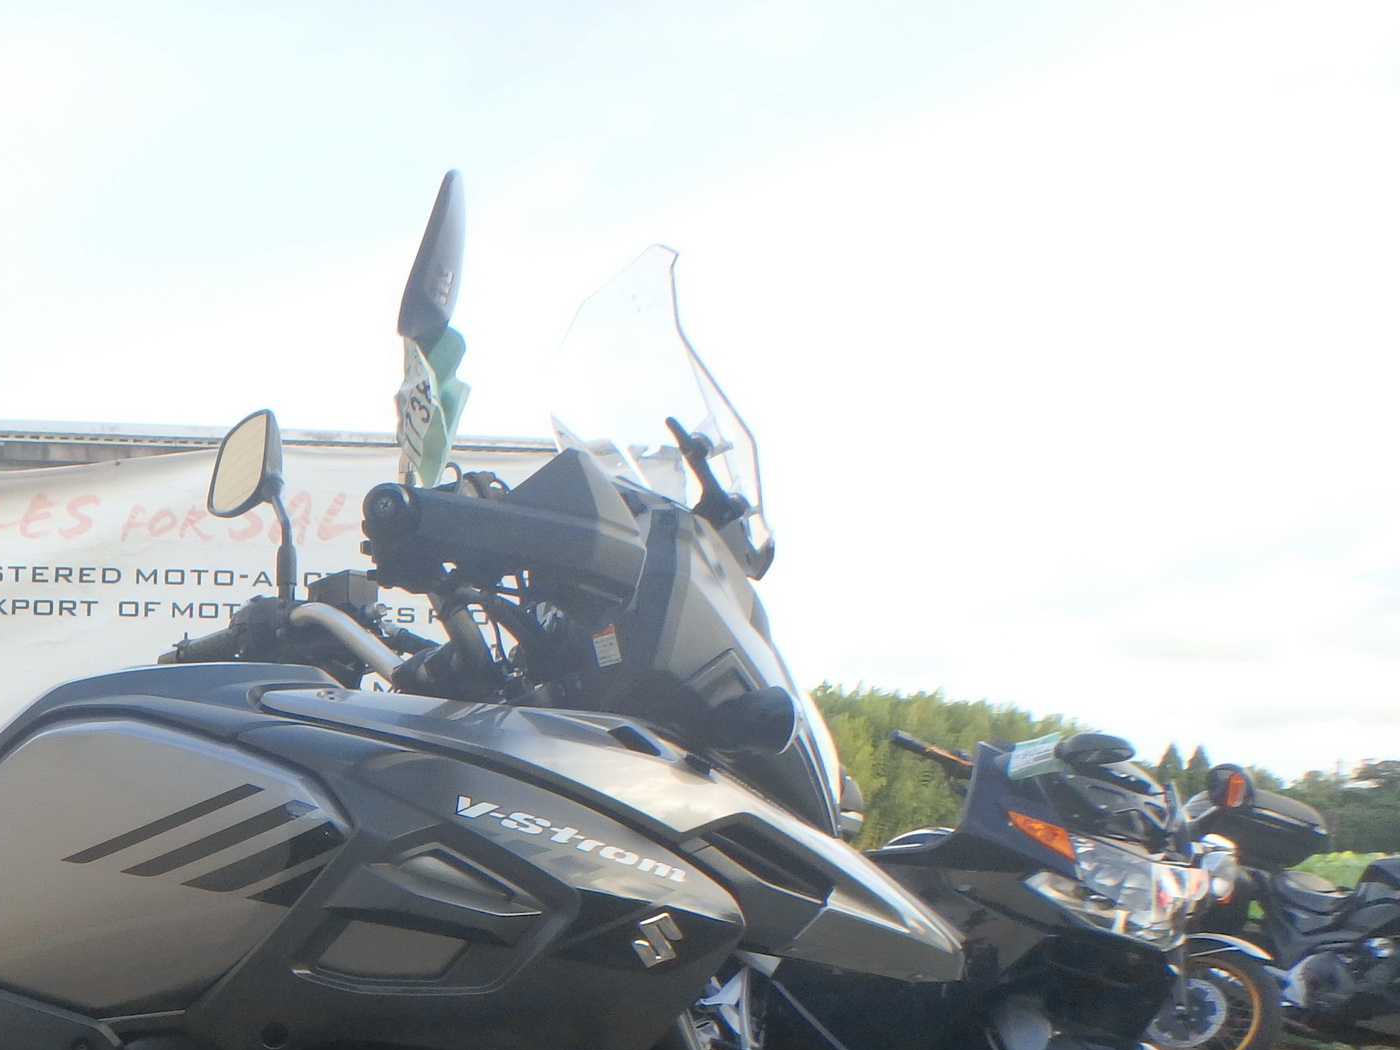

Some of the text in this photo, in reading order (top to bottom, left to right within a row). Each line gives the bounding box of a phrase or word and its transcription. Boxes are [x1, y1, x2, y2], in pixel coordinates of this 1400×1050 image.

[121, 504, 214, 542] FOR
[227, 490, 363, 545] SAL
[118, 601, 161, 618] OF
[456, 795, 687, 883] V-Strom
